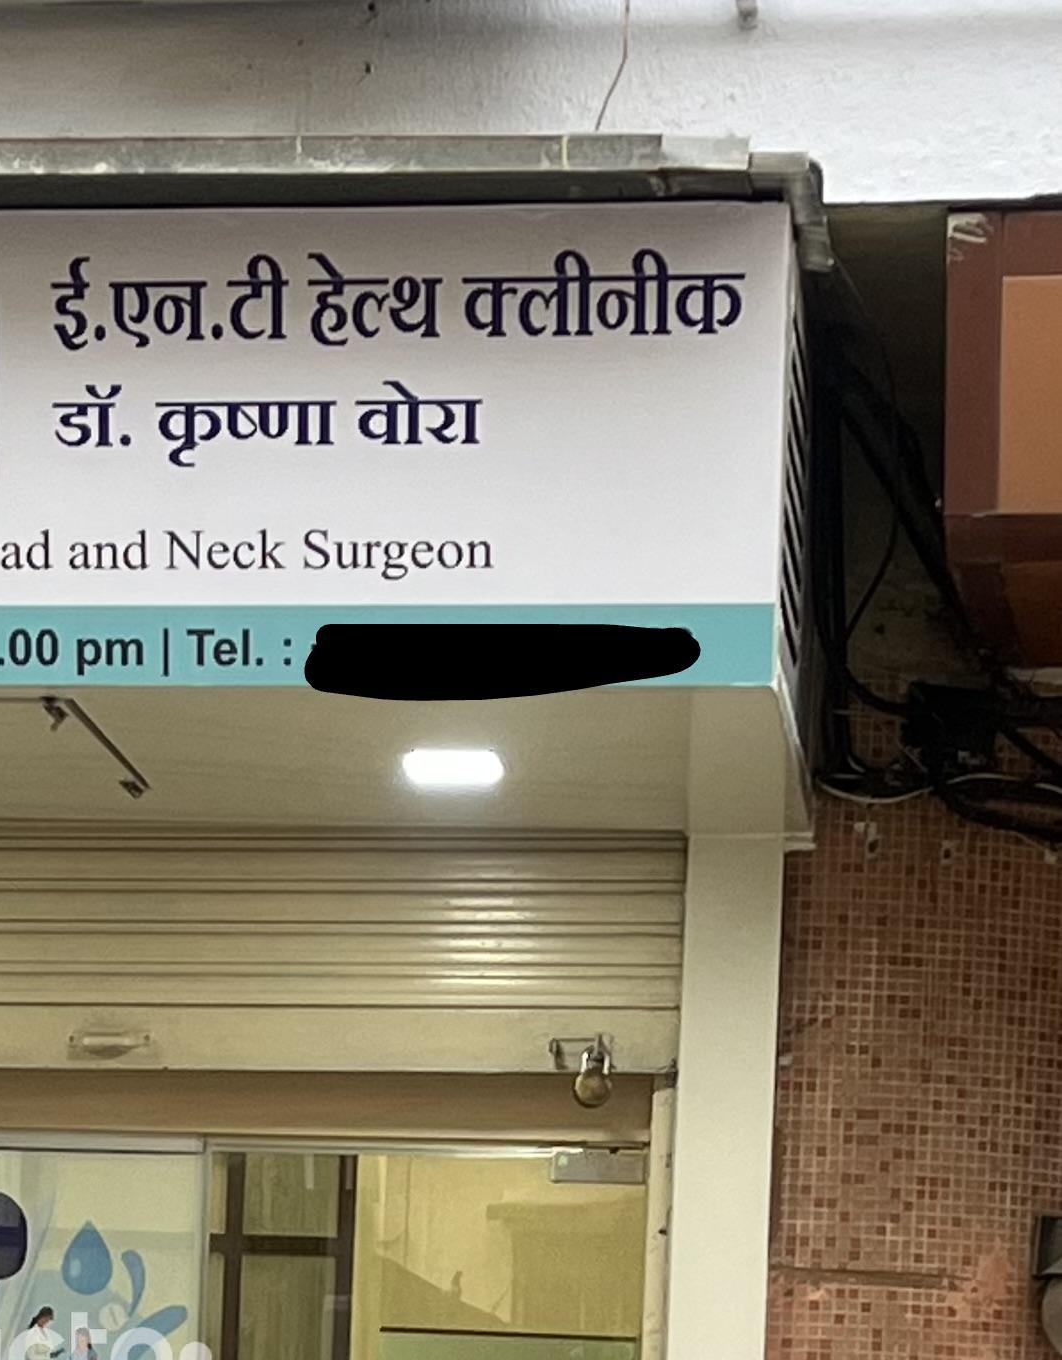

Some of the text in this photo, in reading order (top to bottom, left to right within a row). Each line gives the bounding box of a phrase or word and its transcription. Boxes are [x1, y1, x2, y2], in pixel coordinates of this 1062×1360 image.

[50, 248, 745, 351] ई.एन.टी हेल्थ क्लीनीक
[53, 381, 482, 467] डॉ. कृष्णा वोरा
[69, 529, 149, 570] and
[166, 531, 285, 570] Neck
[302, 531, 493, 580] Surgeon
[77, 635, 145, 675] pm
[188, 630, 266, 667] Tel.
